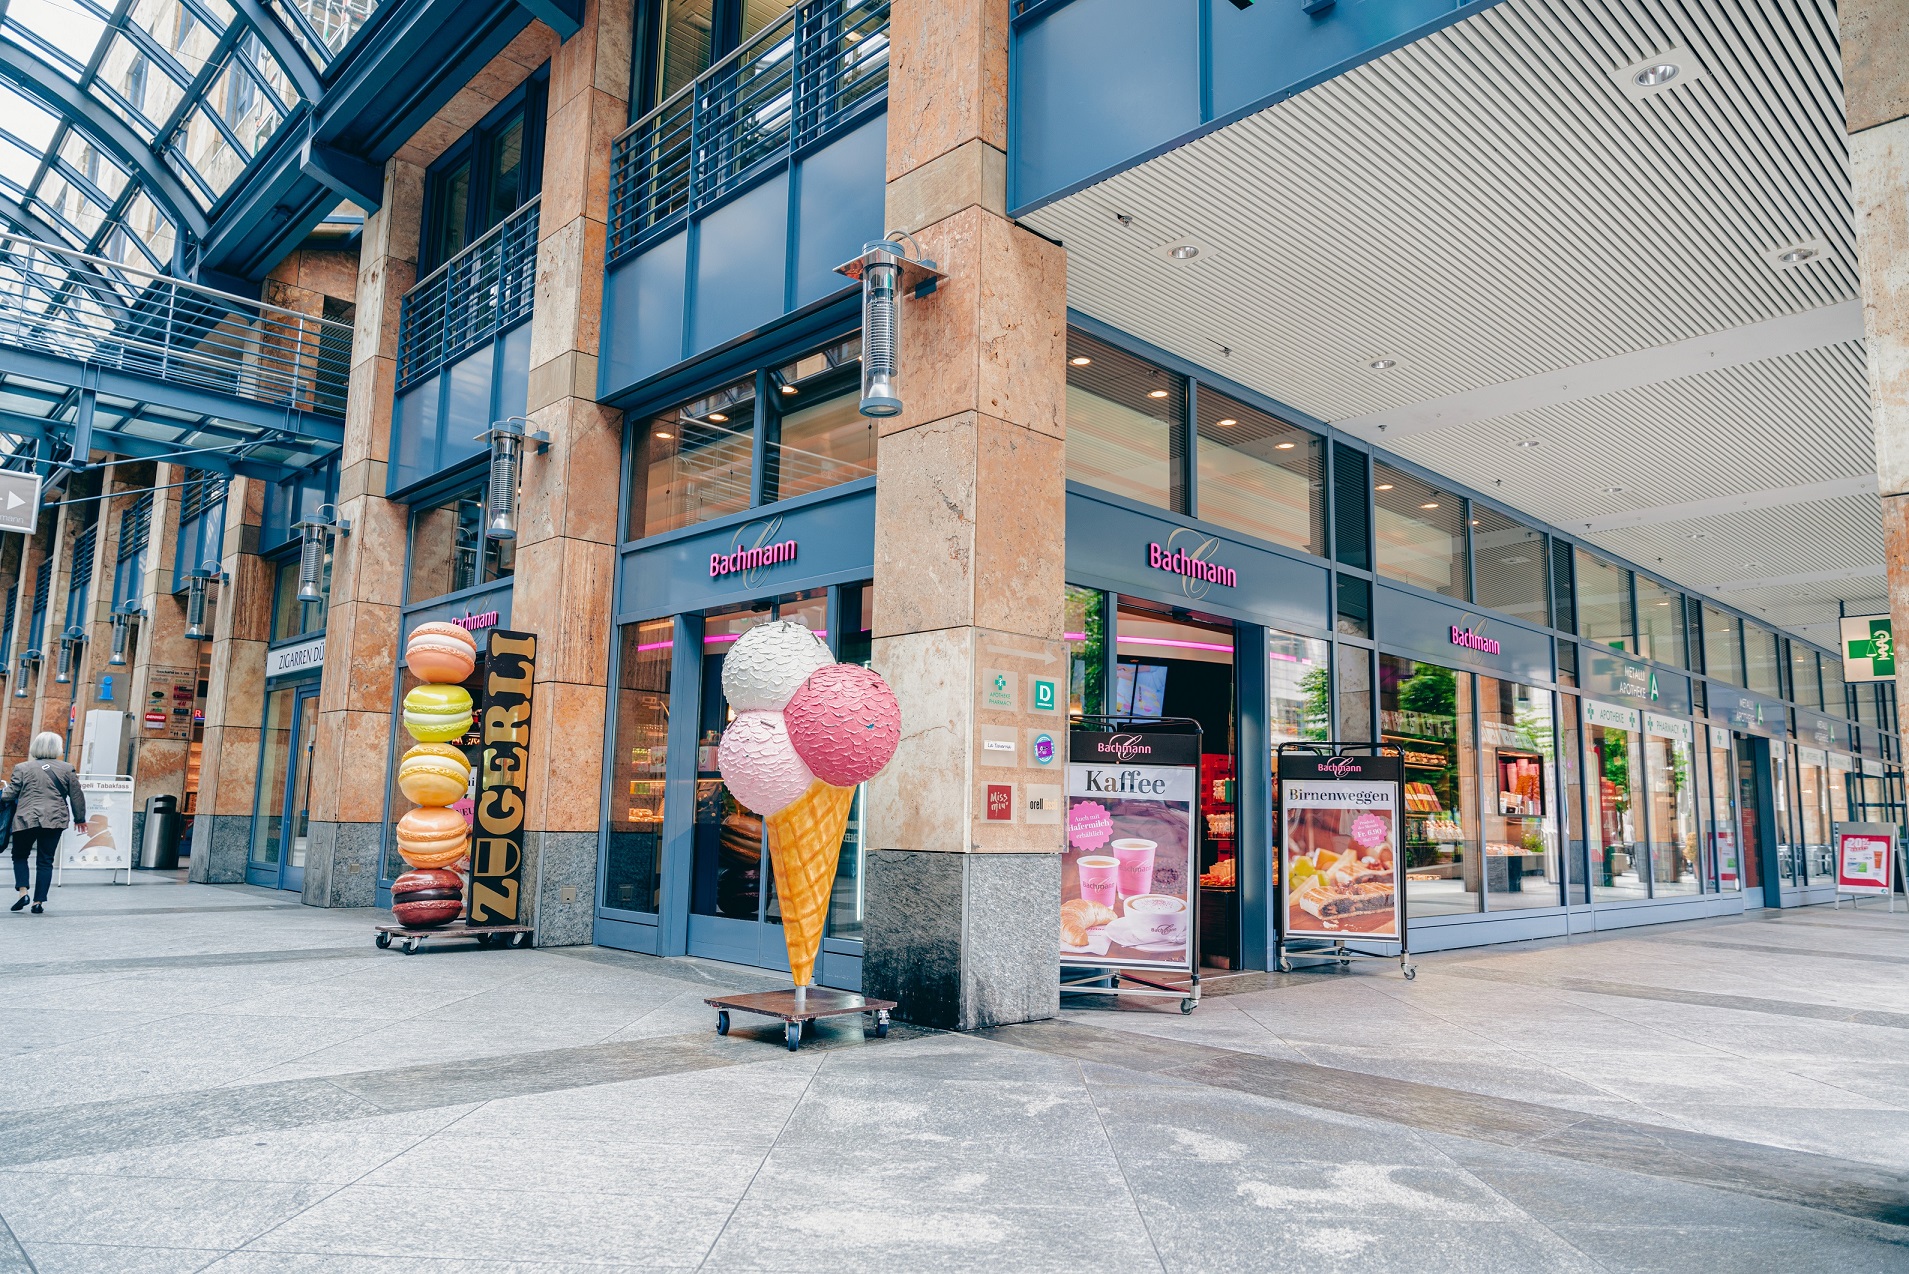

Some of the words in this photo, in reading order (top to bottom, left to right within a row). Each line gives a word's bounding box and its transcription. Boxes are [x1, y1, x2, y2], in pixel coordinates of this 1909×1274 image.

[709, 540, 797, 577] Bachmann
[1149, 542, 1237, 588] Bachmann
[1451, 625, 1500, 655] Bachmann
[278, 648, 312, 670] ZIGARREN
[1624, 665, 1646, 682] METALLI
[989, 692, 1011, 700] APOTHEKE
[1039, 684, 1051, 702] D
[1619, 681, 1647, 699] APOTHEKE
[988, 699, 1012, 707] PHARMACY
[1600, 709, 1624, 724] APOTHEKE
[1656, 720, 1680, 734] PHARMACY
[1097, 742, 1152, 754] Bachmann
[1317, 763, 1362, 773] Bachmann
[97, 782, 130, 790] Tabakfass
[1085, 769, 1166, 795] Kaffee
[990, 792, 1008, 802] Miss
[1289, 788, 1389, 805] Birnenweggen
[1029, 798, 1044, 810] orell
[1074, 815, 1089, 823] Auch
[1075, 830, 1104, 839] erhältlich
[1367, 828, 1382, 836] 6.90
